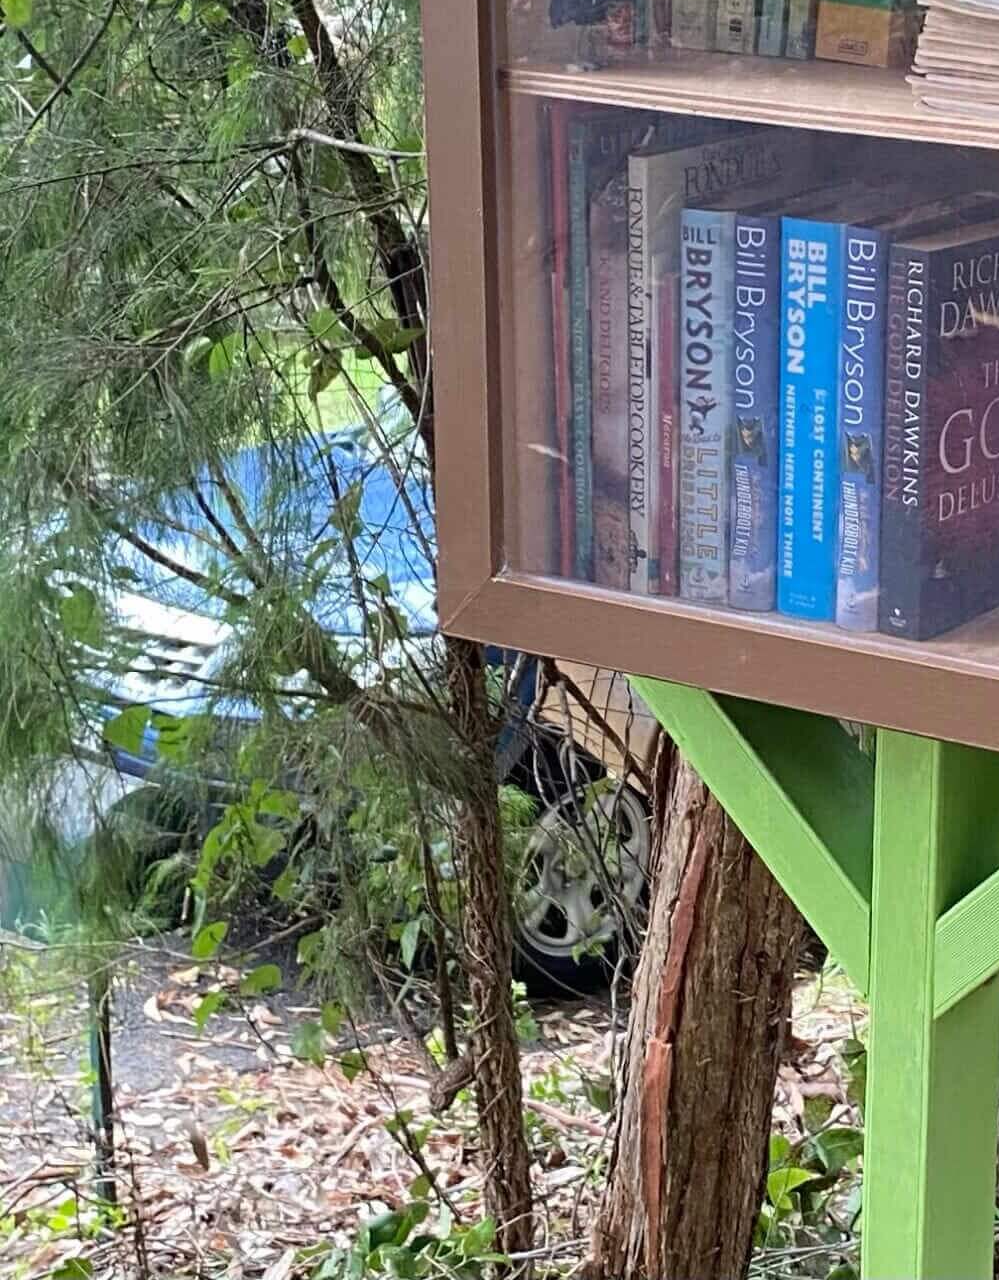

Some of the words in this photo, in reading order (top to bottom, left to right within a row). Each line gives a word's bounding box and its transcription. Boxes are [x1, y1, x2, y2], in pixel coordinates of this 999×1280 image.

[629, 186, 645, 279] FONDUE
[683, 224, 718, 245] BILL
[736, 225, 767, 277] Bill
[847, 238, 877, 292] Bill
[599, 274, 611, 316] AND
[630, 282, 645, 299] &
[786, 239, 807, 375] BRYSON
[807, 240, 828, 309] BILL
[889, 260, 906, 305] THE
[686, 246, 714, 391] BRYSON
[734, 285, 767, 409] Bryson
[888, 313, 905, 370] GOD
[905, 260, 924, 380] RICHARD
[599, 319, 612, 414] DELICIOUS
[629, 301, 646, 414] TABLETOP
[843, 298, 876, 425] Bryson
[785, 383, 797, 448] NEITHER
[813, 405, 826, 445] LOST
[886, 379, 904, 502] DELUSION
[902, 390, 921, 507] DAWKINS
[630, 413, 647, 519] COOKERY
[681, 446, 698, 558] DRIBBLING
[735, 463, 753, 537] THUNDERBOLT
[784, 452, 796, 491] HERE
[812, 448, 826, 543] CONTINENT
[696, 447, 720, 561] LITTLE
[783, 495, 795, 527] NOR
[841, 480, 860, 555] THUNDERBOLT
[734, 536, 749, 557] KID
[783, 531, 795, 578] THERE
[840, 555, 857, 576] KID
